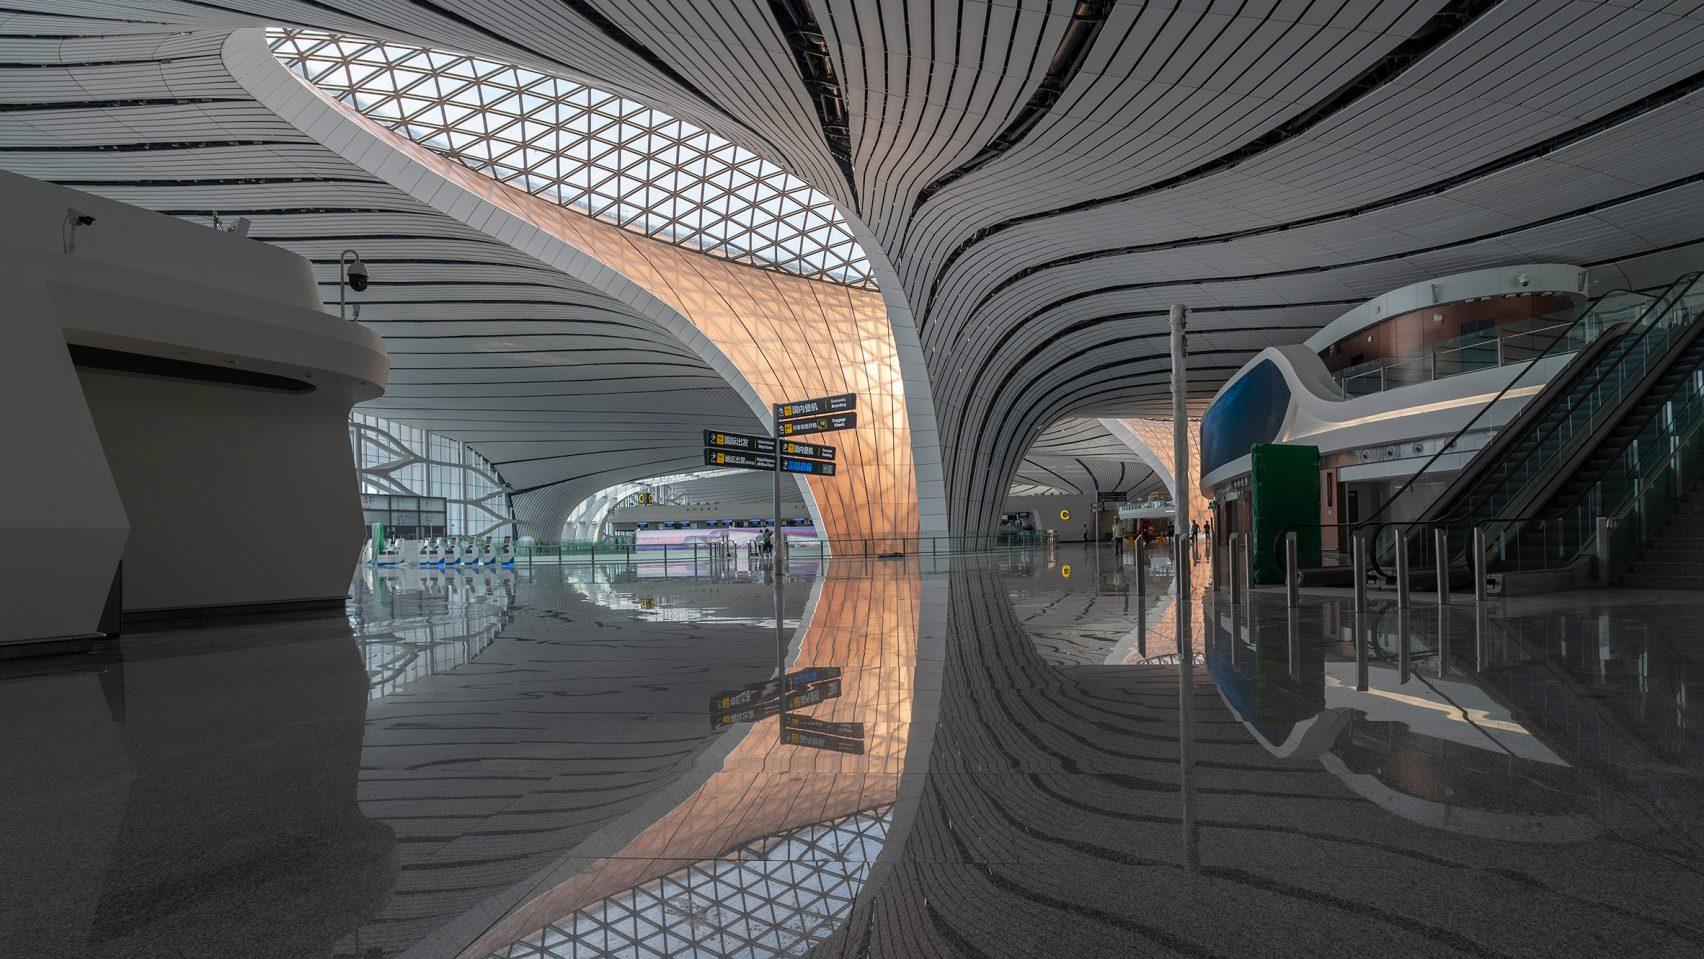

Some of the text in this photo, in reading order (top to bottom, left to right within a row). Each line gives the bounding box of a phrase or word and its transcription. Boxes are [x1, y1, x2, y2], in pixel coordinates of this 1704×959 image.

[793, 402, 818, 414] 国内登机
[725, 436, 749, 447] 国际出发
[1060, 510, 1070, 520] C
